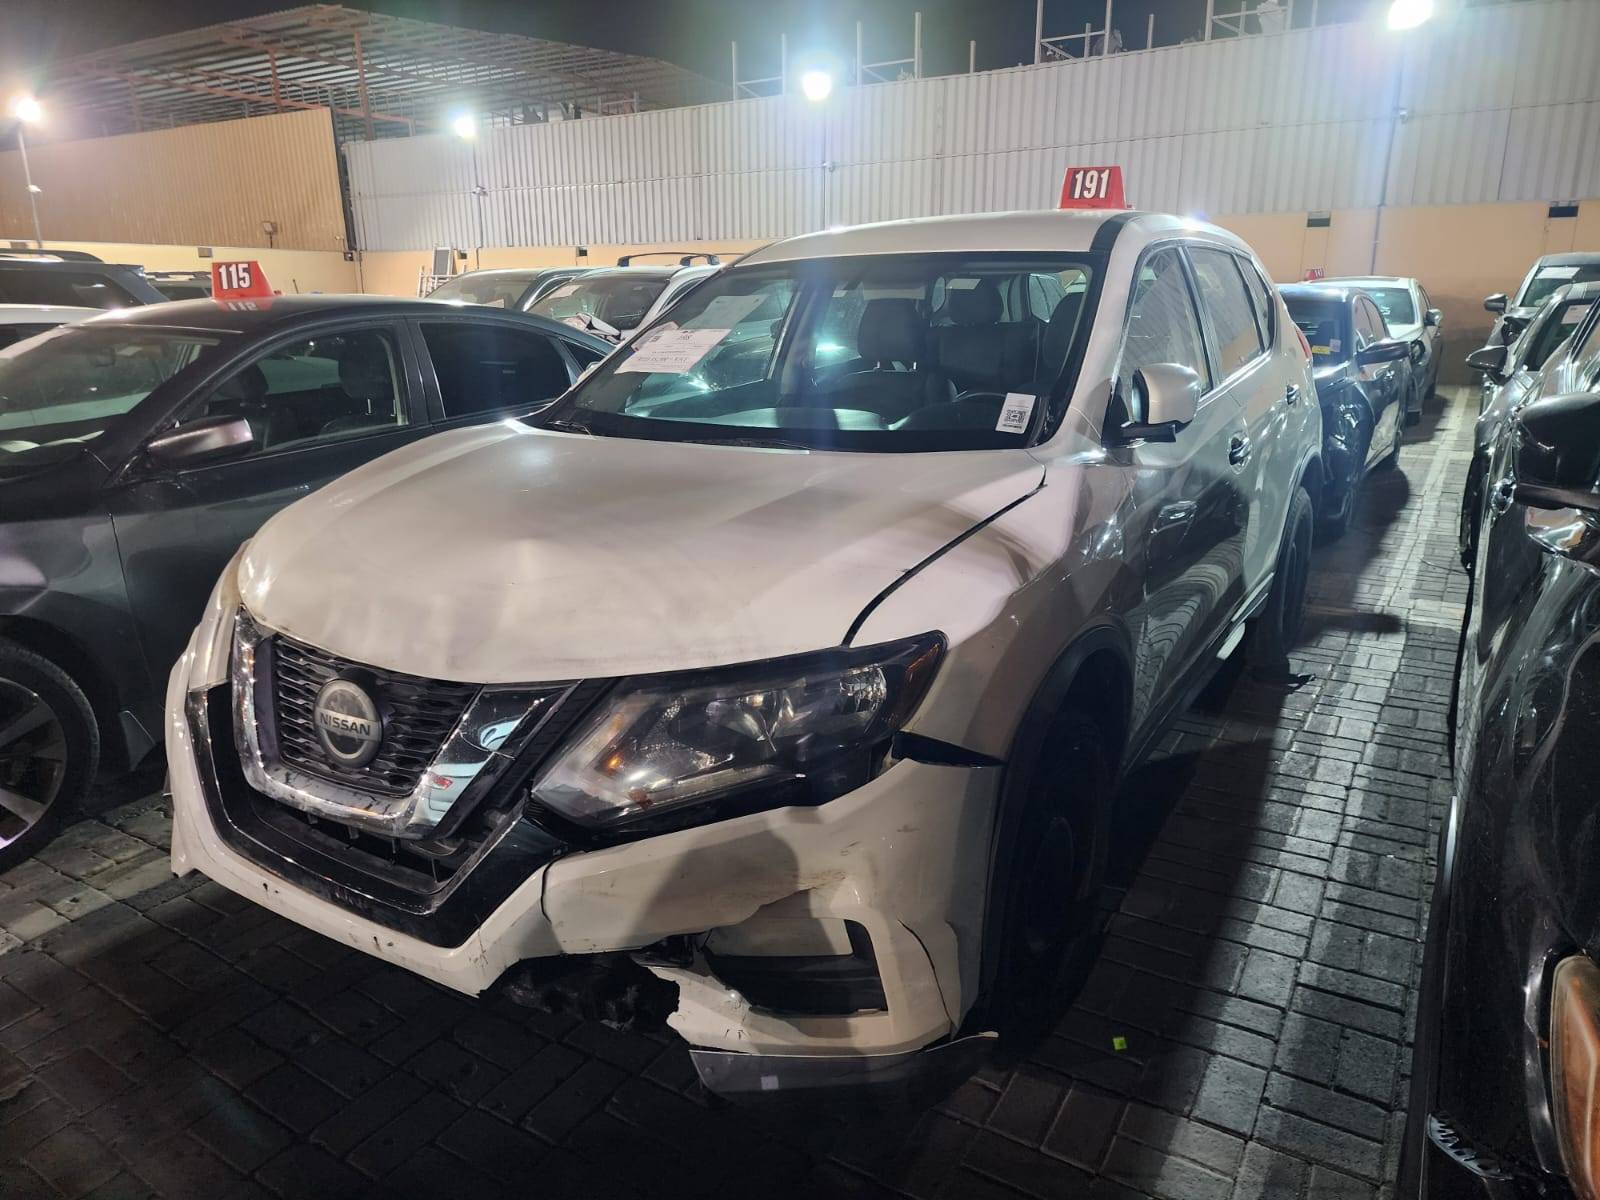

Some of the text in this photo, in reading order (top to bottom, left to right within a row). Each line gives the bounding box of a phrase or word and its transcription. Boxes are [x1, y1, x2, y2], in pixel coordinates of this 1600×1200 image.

[1074, 169, 1110, 198] 191
[219, 263, 250, 289] 115
[320, 712, 371, 736] NISSAN
